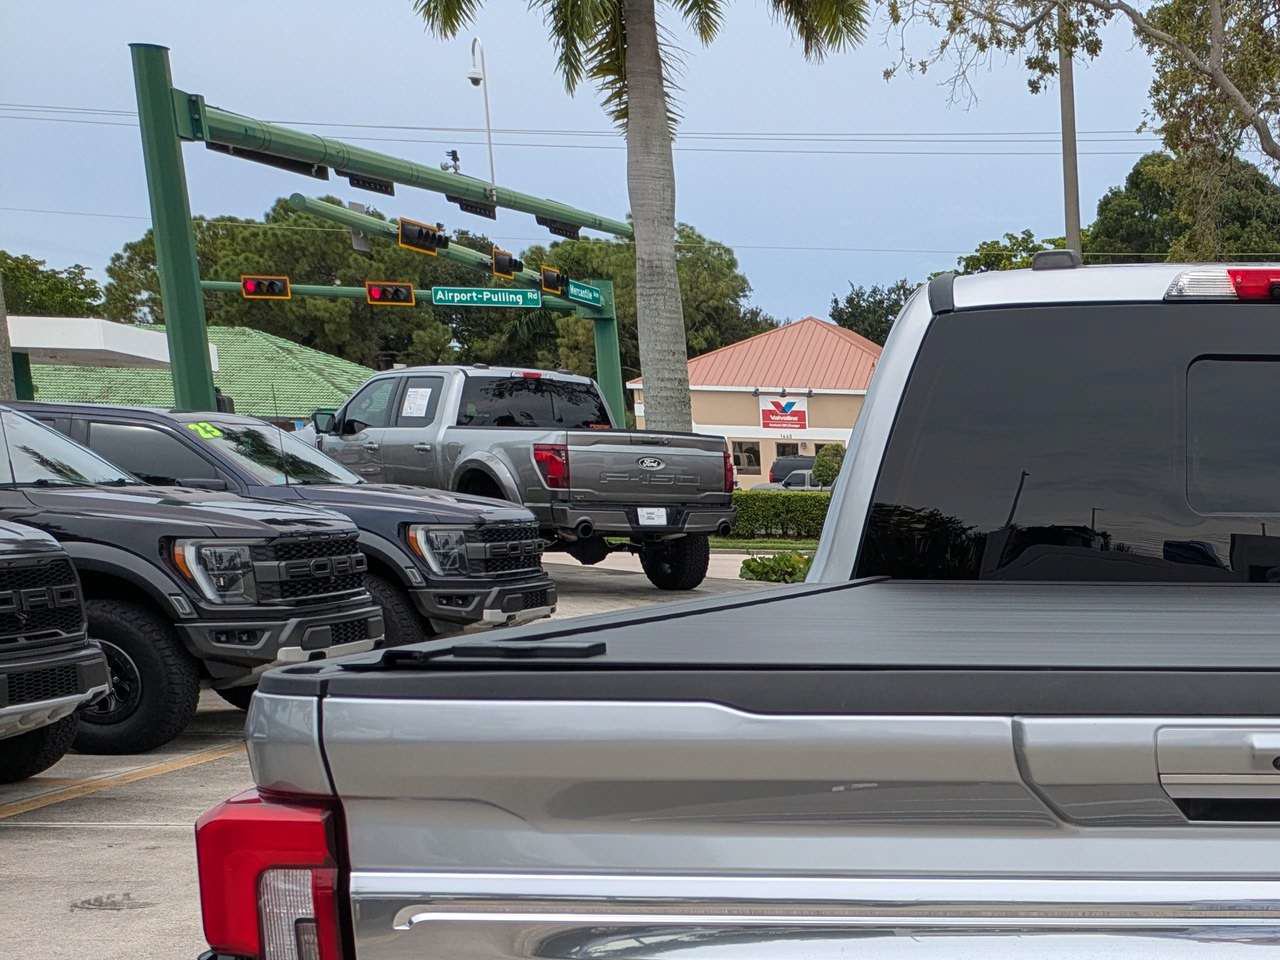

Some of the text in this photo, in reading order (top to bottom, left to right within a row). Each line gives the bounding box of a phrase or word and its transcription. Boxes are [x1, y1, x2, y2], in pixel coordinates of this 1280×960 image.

[436, 290, 538, 305] Airport-Pulling Rd
[188, 422, 223, 439] 23
[279, 553, 368, 580] FORD
